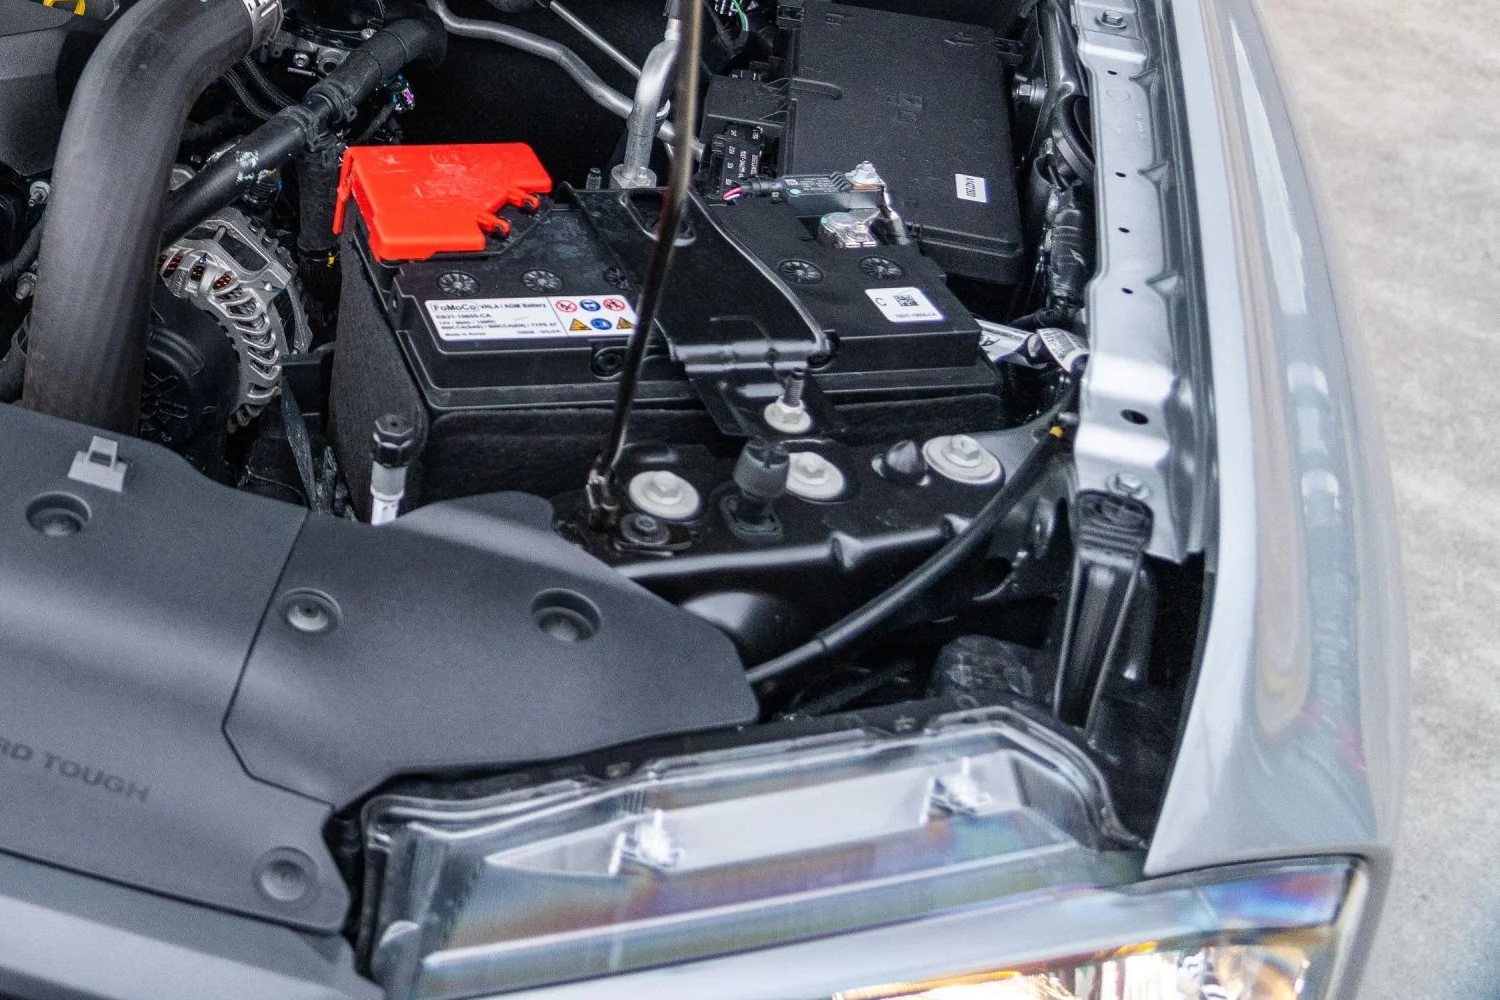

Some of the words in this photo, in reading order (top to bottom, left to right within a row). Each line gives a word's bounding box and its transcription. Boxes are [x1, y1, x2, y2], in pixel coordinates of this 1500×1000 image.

[875, 297, 887, 307] C
[433, 304, 477, 312] FoMoCo
[44, 751, 150, 803] TOUGH
